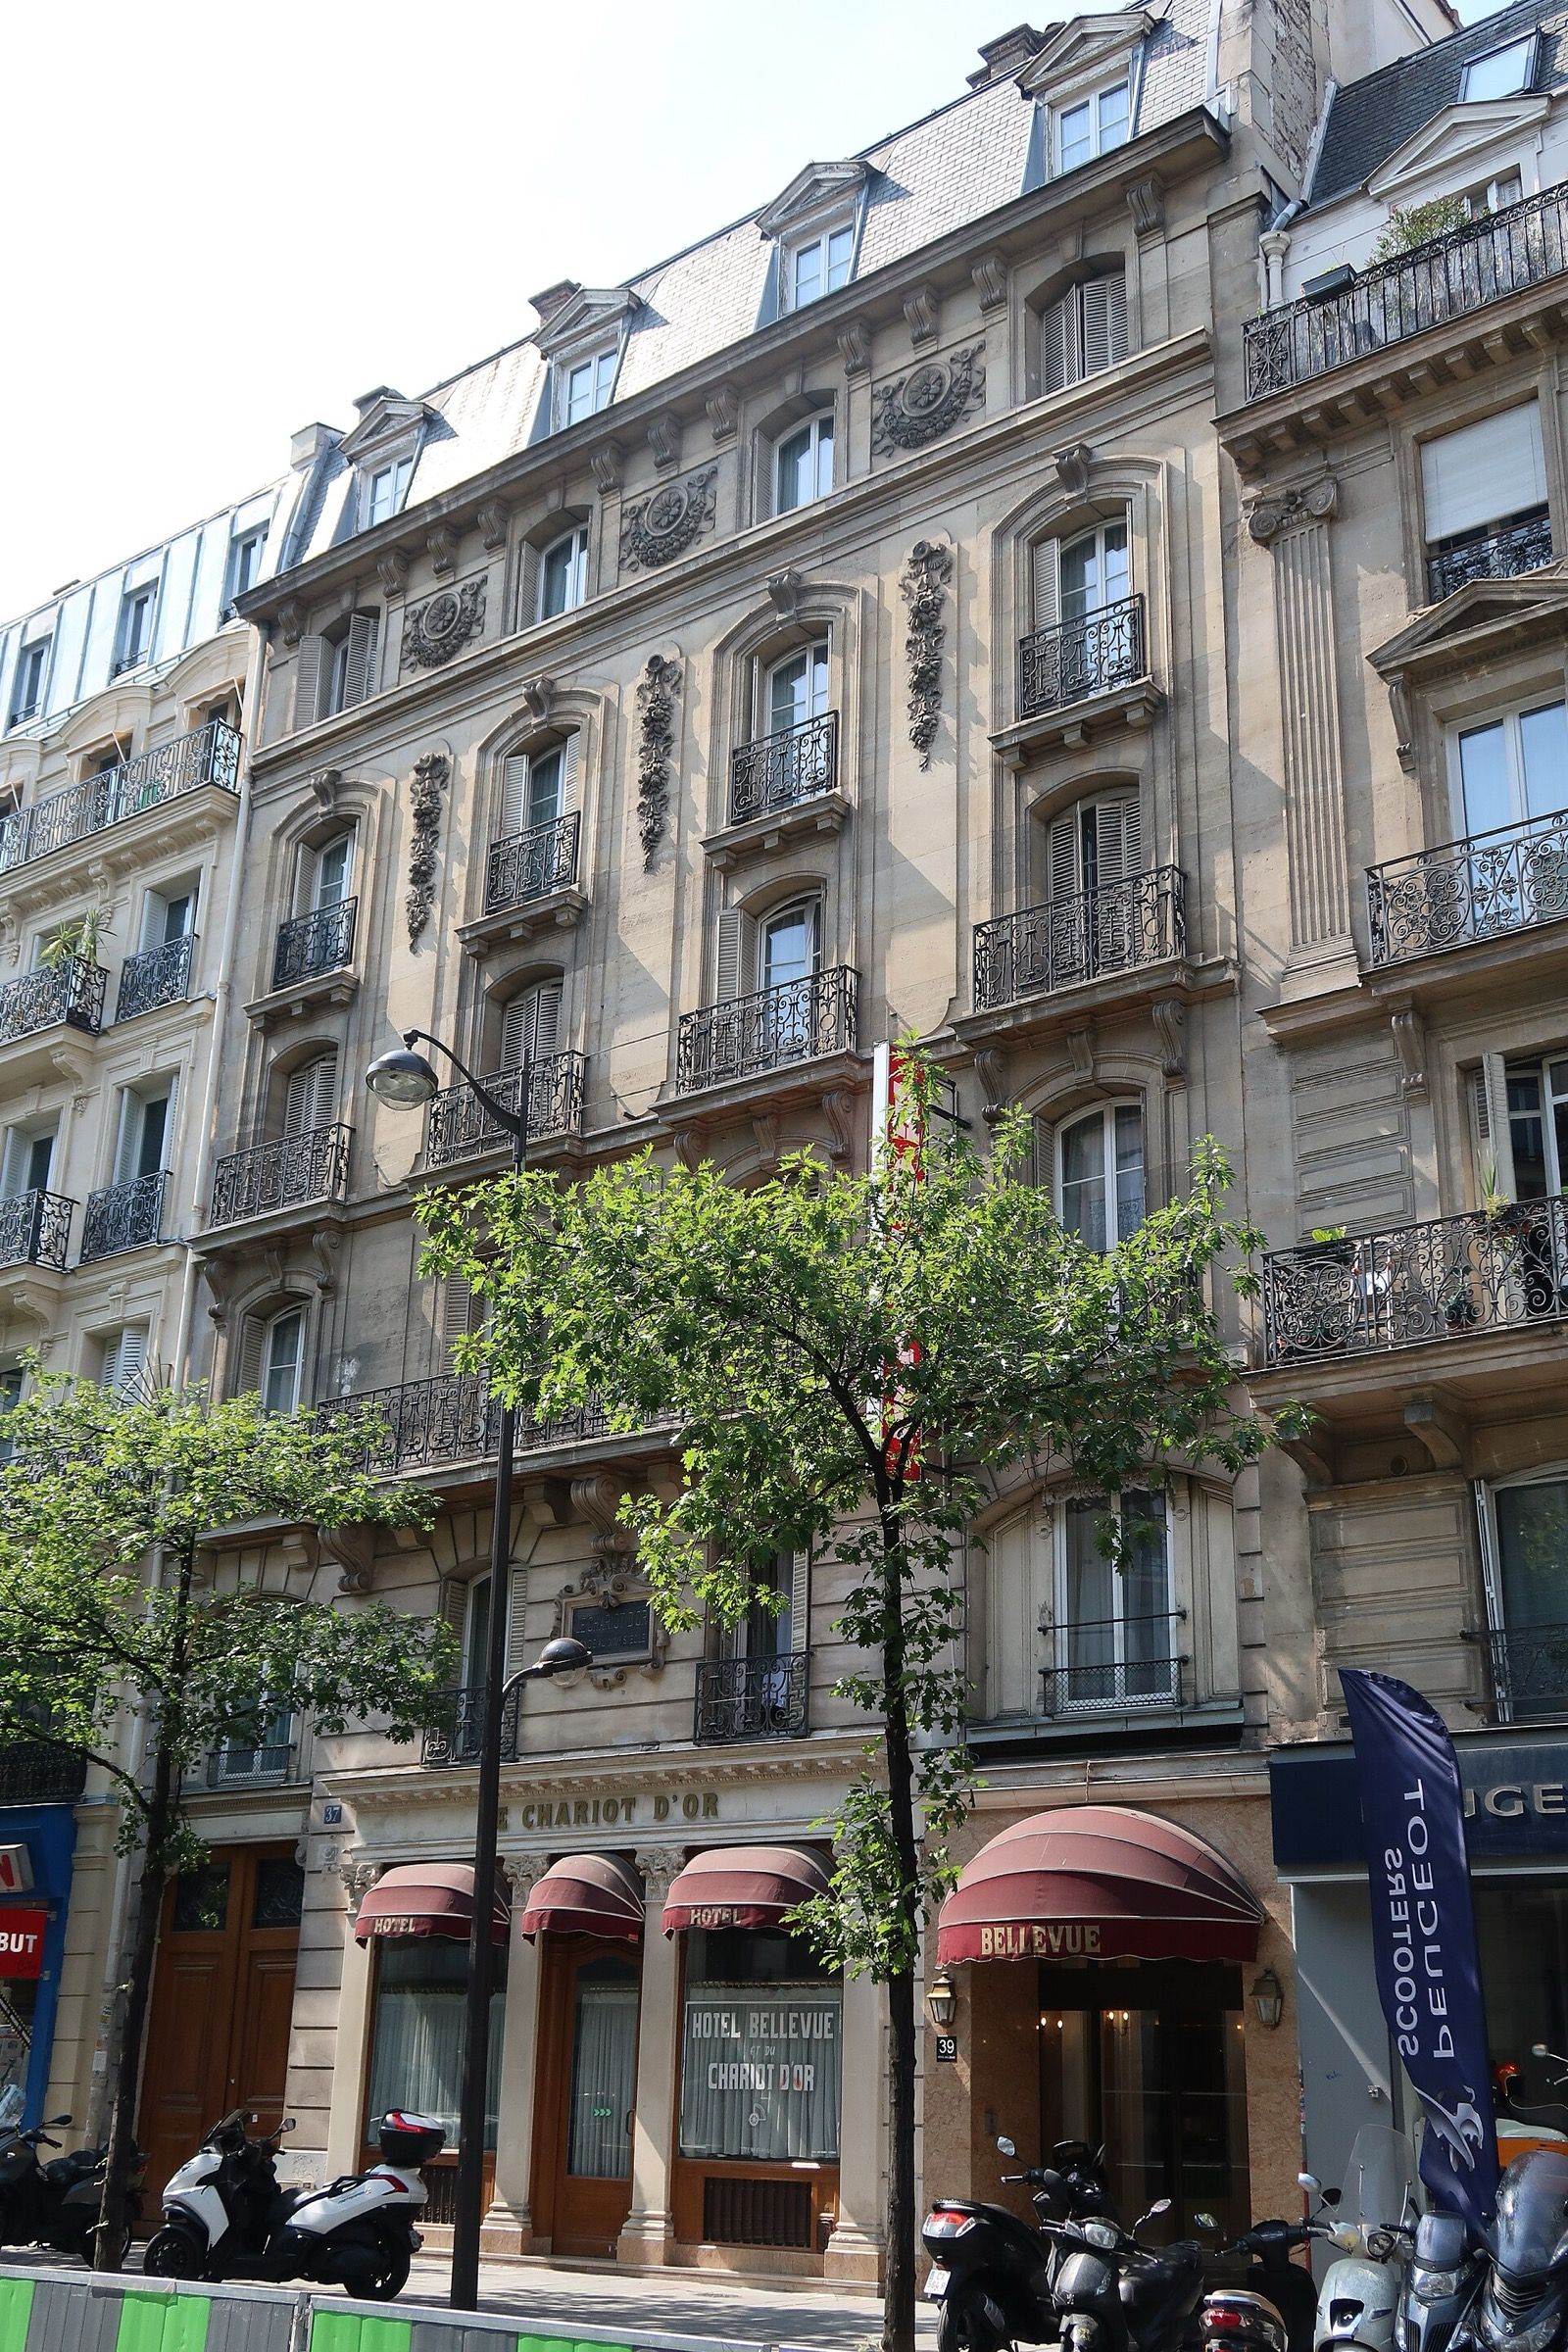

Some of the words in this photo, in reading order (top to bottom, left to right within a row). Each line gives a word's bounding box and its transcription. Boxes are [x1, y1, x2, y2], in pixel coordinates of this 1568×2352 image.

[324, 1805, 340, 1823] 37
[522, 1796, 636, 1829] CHARIOT
[654, 1792, 718, 1821] D'OR
[373, 1917, 416, 1934] HOTEL
[690, 1908, 741, 1925] HOTEL
[981, 1925, 1101, 1955] BELLEVUE
[692, 2012, 741, 2038] HOTEL
[749, 2012, 834, 2039] BELLEVUE
[750, 2045, 760, 2056] ET
[764, 2045, 776, 2056] DU
[939, 2039, 955, 2054] 39
[708, 2062, 774, 2090] CHARIOT
[779, 2061, 814, 2091] D'OR
